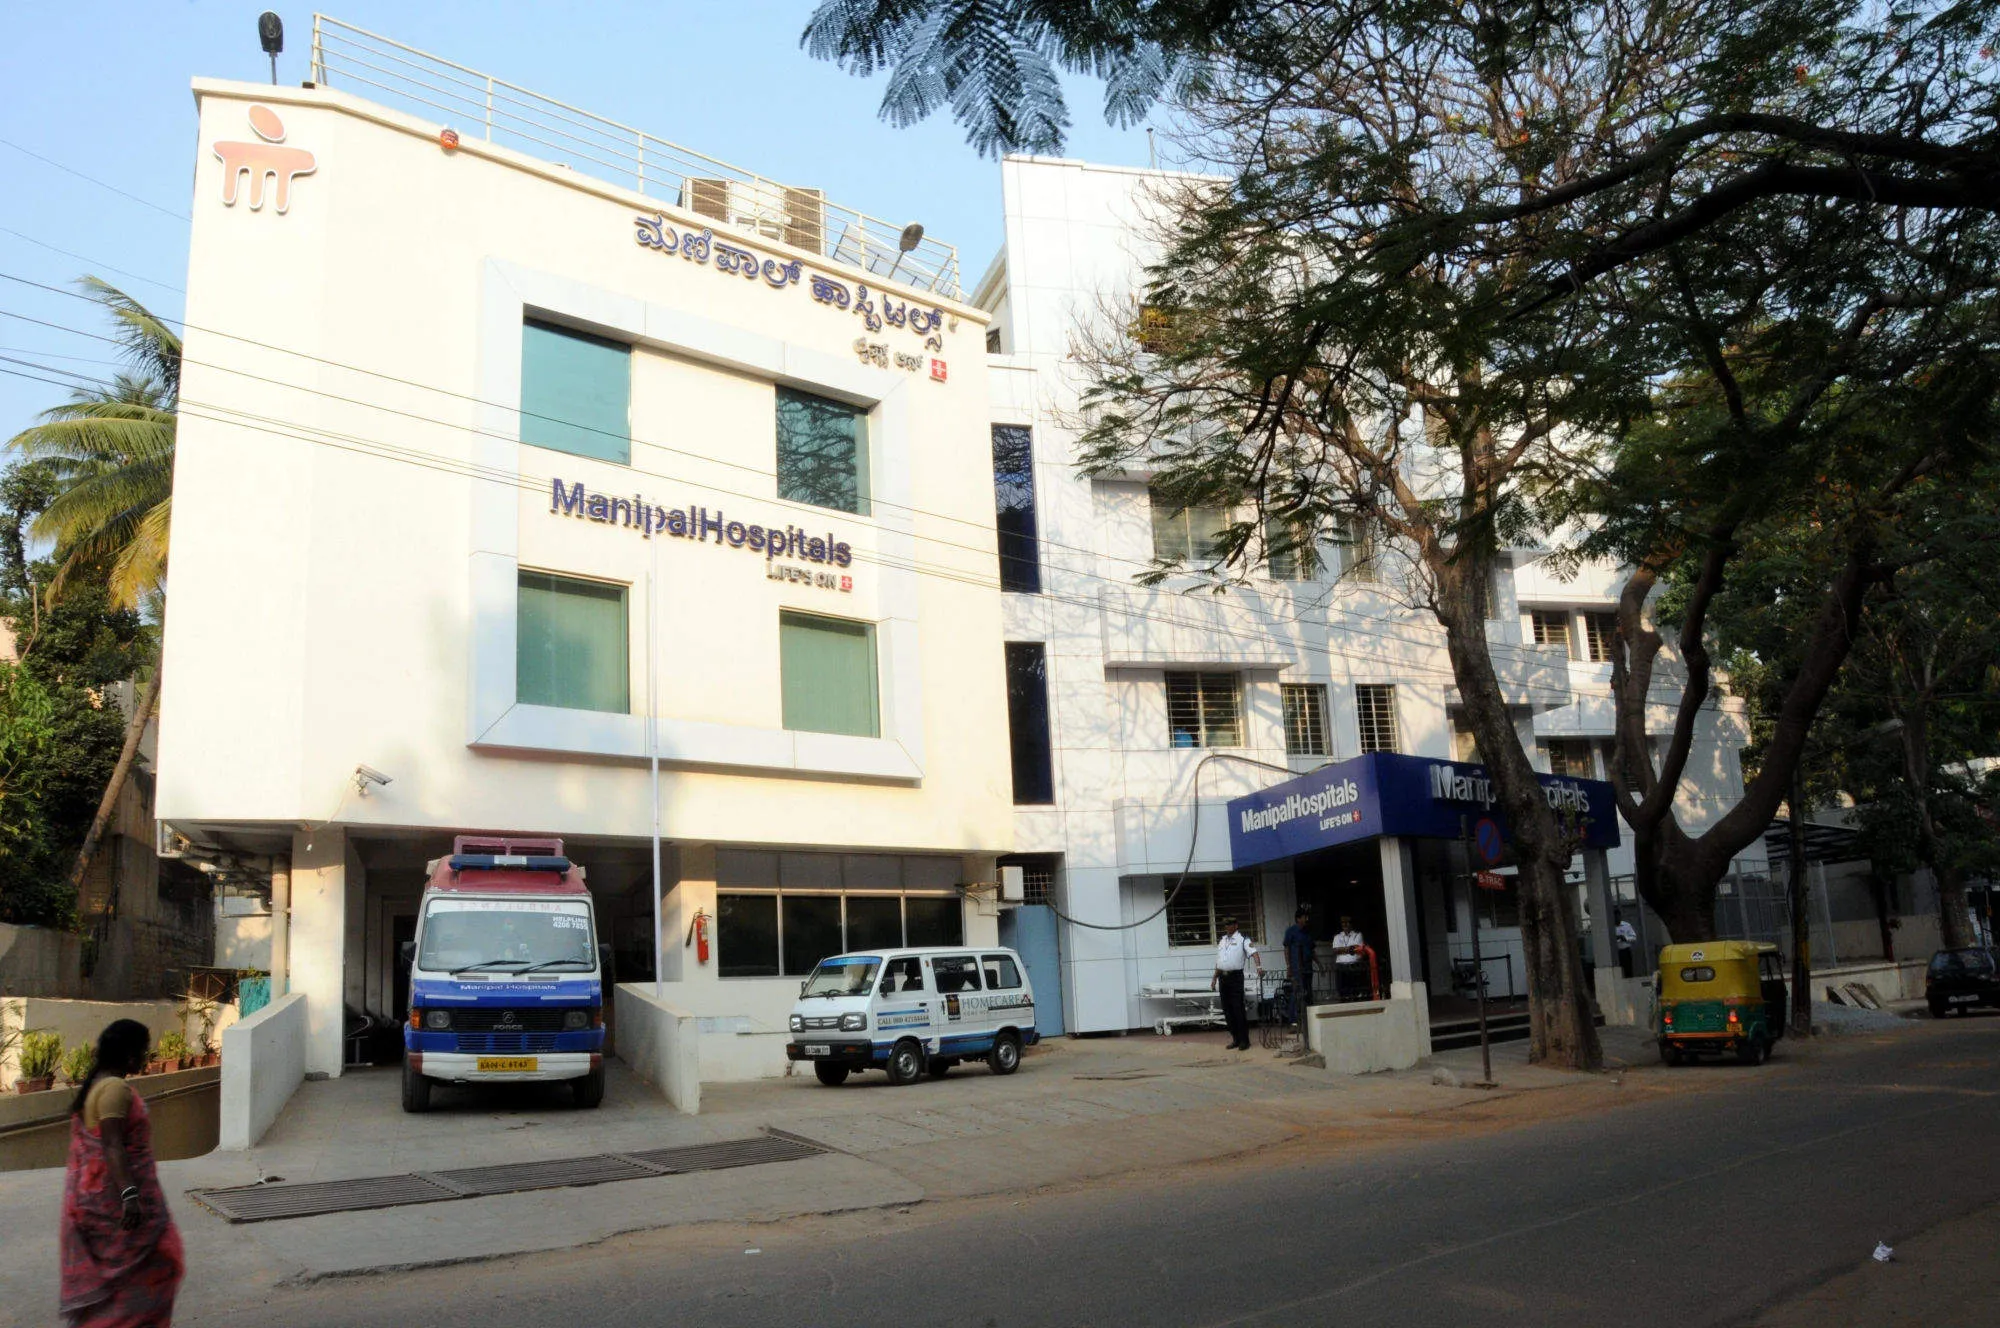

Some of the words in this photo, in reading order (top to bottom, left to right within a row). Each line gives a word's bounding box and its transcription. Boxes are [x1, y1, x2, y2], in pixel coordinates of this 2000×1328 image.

[551, 477, 852, 568] ManipalHospitals
[767, 565, 812, 586] LIFE'S
[814, 571, 837, 590] ON
[1241, 778, 1359, 834] ManipalHospitals
[1320, 817, 1341, 831] LIFE'S
[1341, 813, 1353, 825] ON
[962, 993, 1020, 1010] HOMECARE
